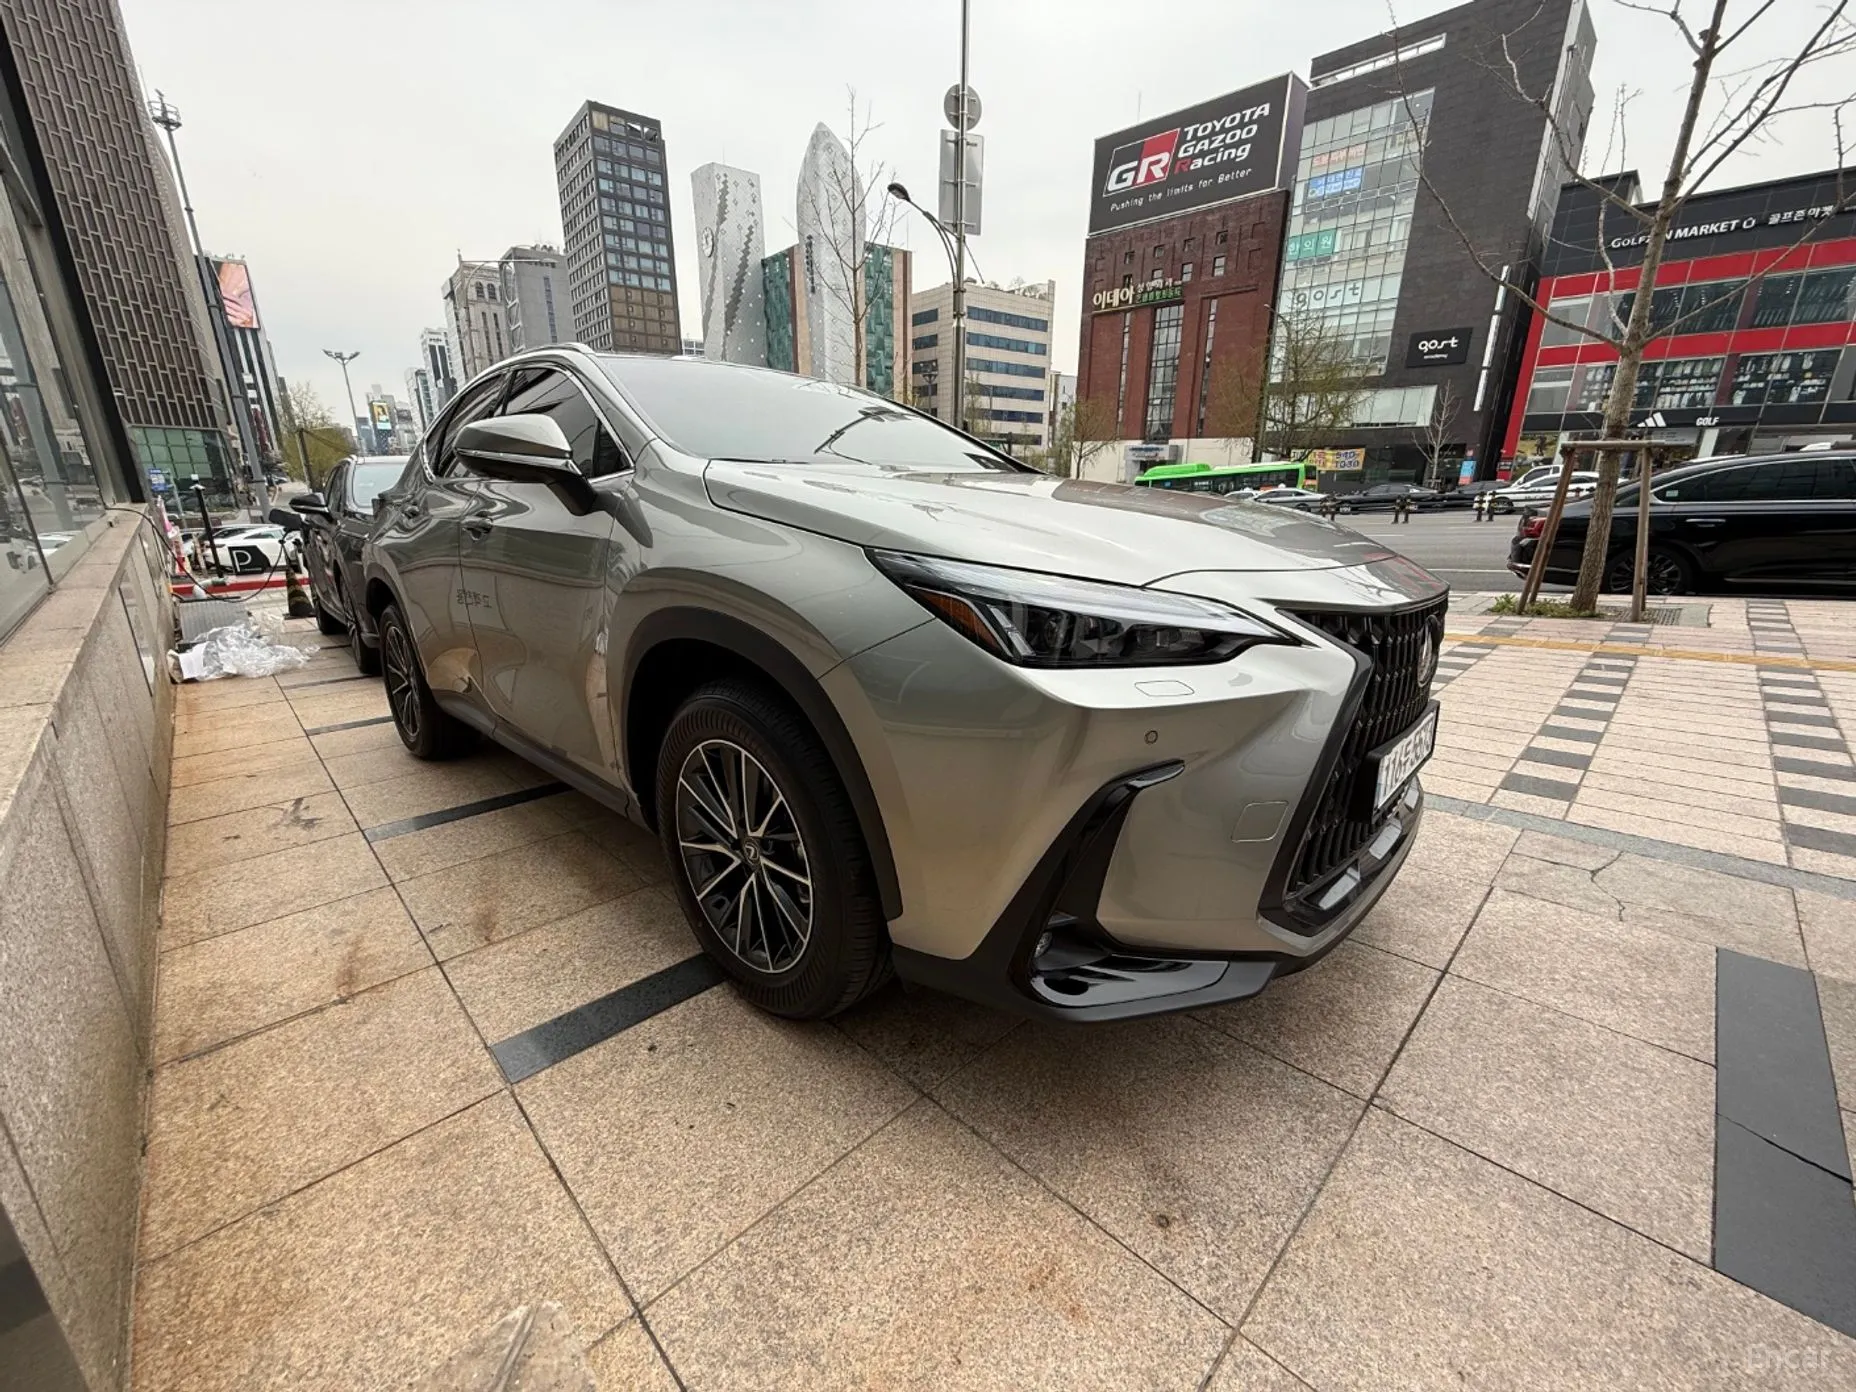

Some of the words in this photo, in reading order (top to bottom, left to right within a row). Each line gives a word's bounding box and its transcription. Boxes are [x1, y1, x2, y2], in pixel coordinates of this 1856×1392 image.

[1184, 102, 1271, 141] TOYOTA
[1177, 124, 1259, 158] GAZOO
[1107, 152, 1171, 191] GR
[1174, 143, 1252, 175] Racing
[1110, 197, 1144, 212] Pushing
[1148, 191, 1163, 202] the
[1167, 184, 1194, 197] limits
[1198, 178, 1213, 189] for
[1218, 168, 1252, 184] Better
[1674, 219, 1740, 240] MARKET
[1093, 285, 1135, 309] 이데아
[1695, 416, 1720, 426] GOLF
